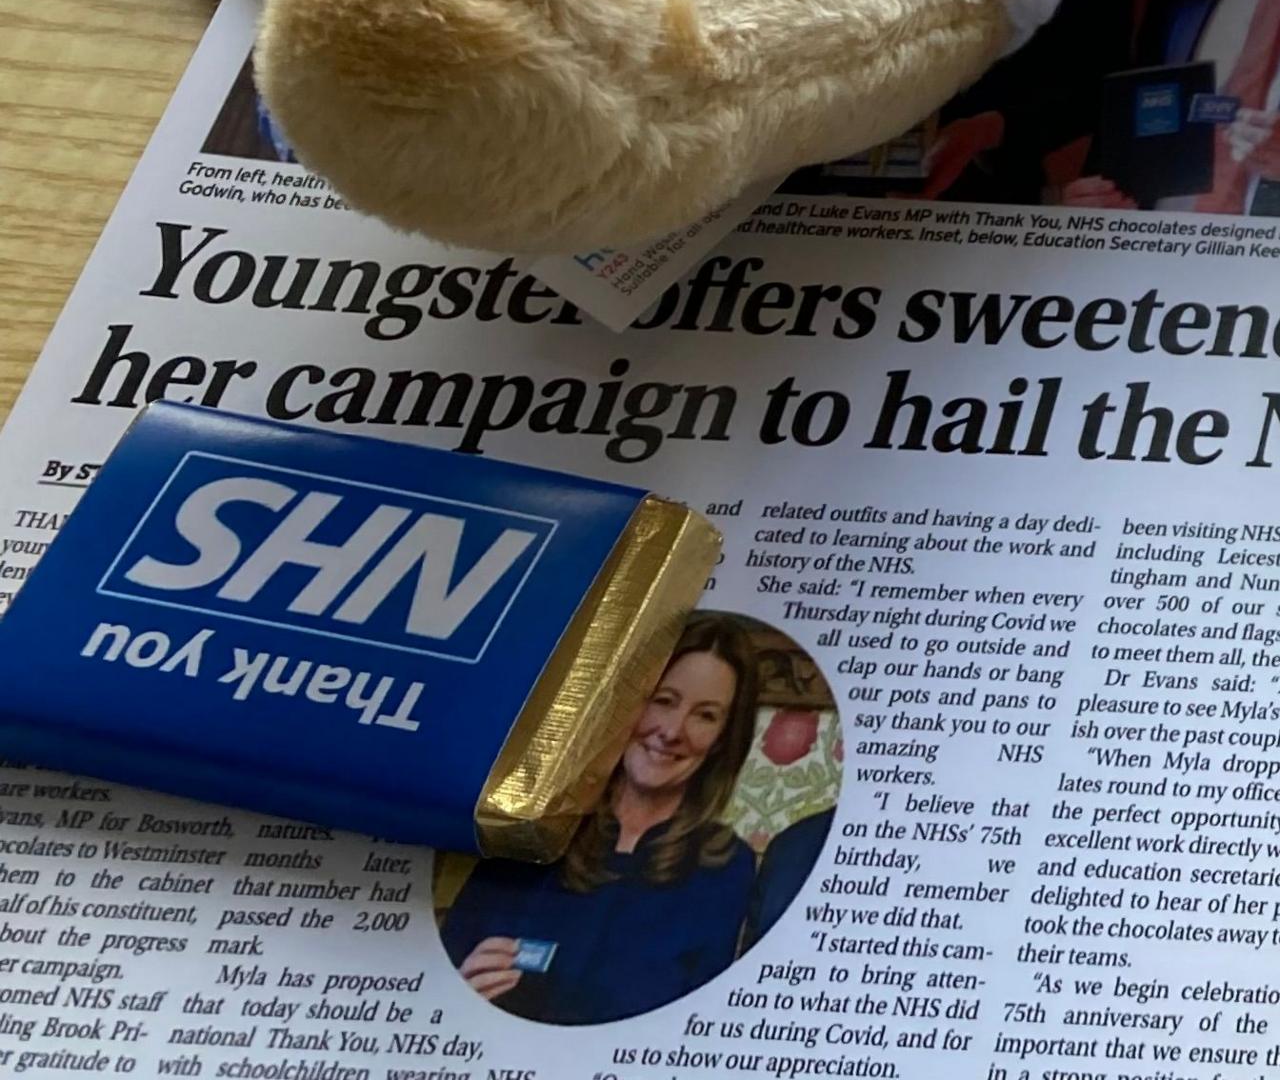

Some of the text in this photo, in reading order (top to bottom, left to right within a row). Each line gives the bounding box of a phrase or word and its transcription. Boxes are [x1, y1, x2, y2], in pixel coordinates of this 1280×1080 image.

[179, 180, 321, 208] Godwin, who has
[187, 162, 328, 190] From left, health
[755, 219, 843, 237] healthcare
[847, 225, 914, 240] workers.
[919, 227, 963, 245] Inset,
[968, 229, 1018, 247] below,
[1023, 232, 1105, 249] Education
[1109, 236, 1192, 257] Secretary
[1195, 240, 1245, 256] Gillian
[785, 202, 807, 217] Dr
[808, 204, 849, 219] Luke
[852, 206, 901, 222] Evans
[904, 208, 933, 222] MP
[936, 210, 970, 225] with
[976, 211, 1025, 227] Thank
[1031, 214, 1062, 231] You,
[1066, 216, 1105, 231] NHS
[1108, 218, 1197, 236] chocolates
[1201, 222, 1276, 241] designed
[70, 323, 258, 411] her
[266, 356, 739, 465] campaign
[759, 375, 852, 448] to
[863, 369, 1063, 457] hail
[1077, 380, 1230, 466] the
[1122, 518, 1167, 536] been
[1173, 522, 1238, 545] visiting
[124, 475, 536, 641] NHS
[1116, 543, 1205, 567] including
[81, 620, 426, 732] Thank you
